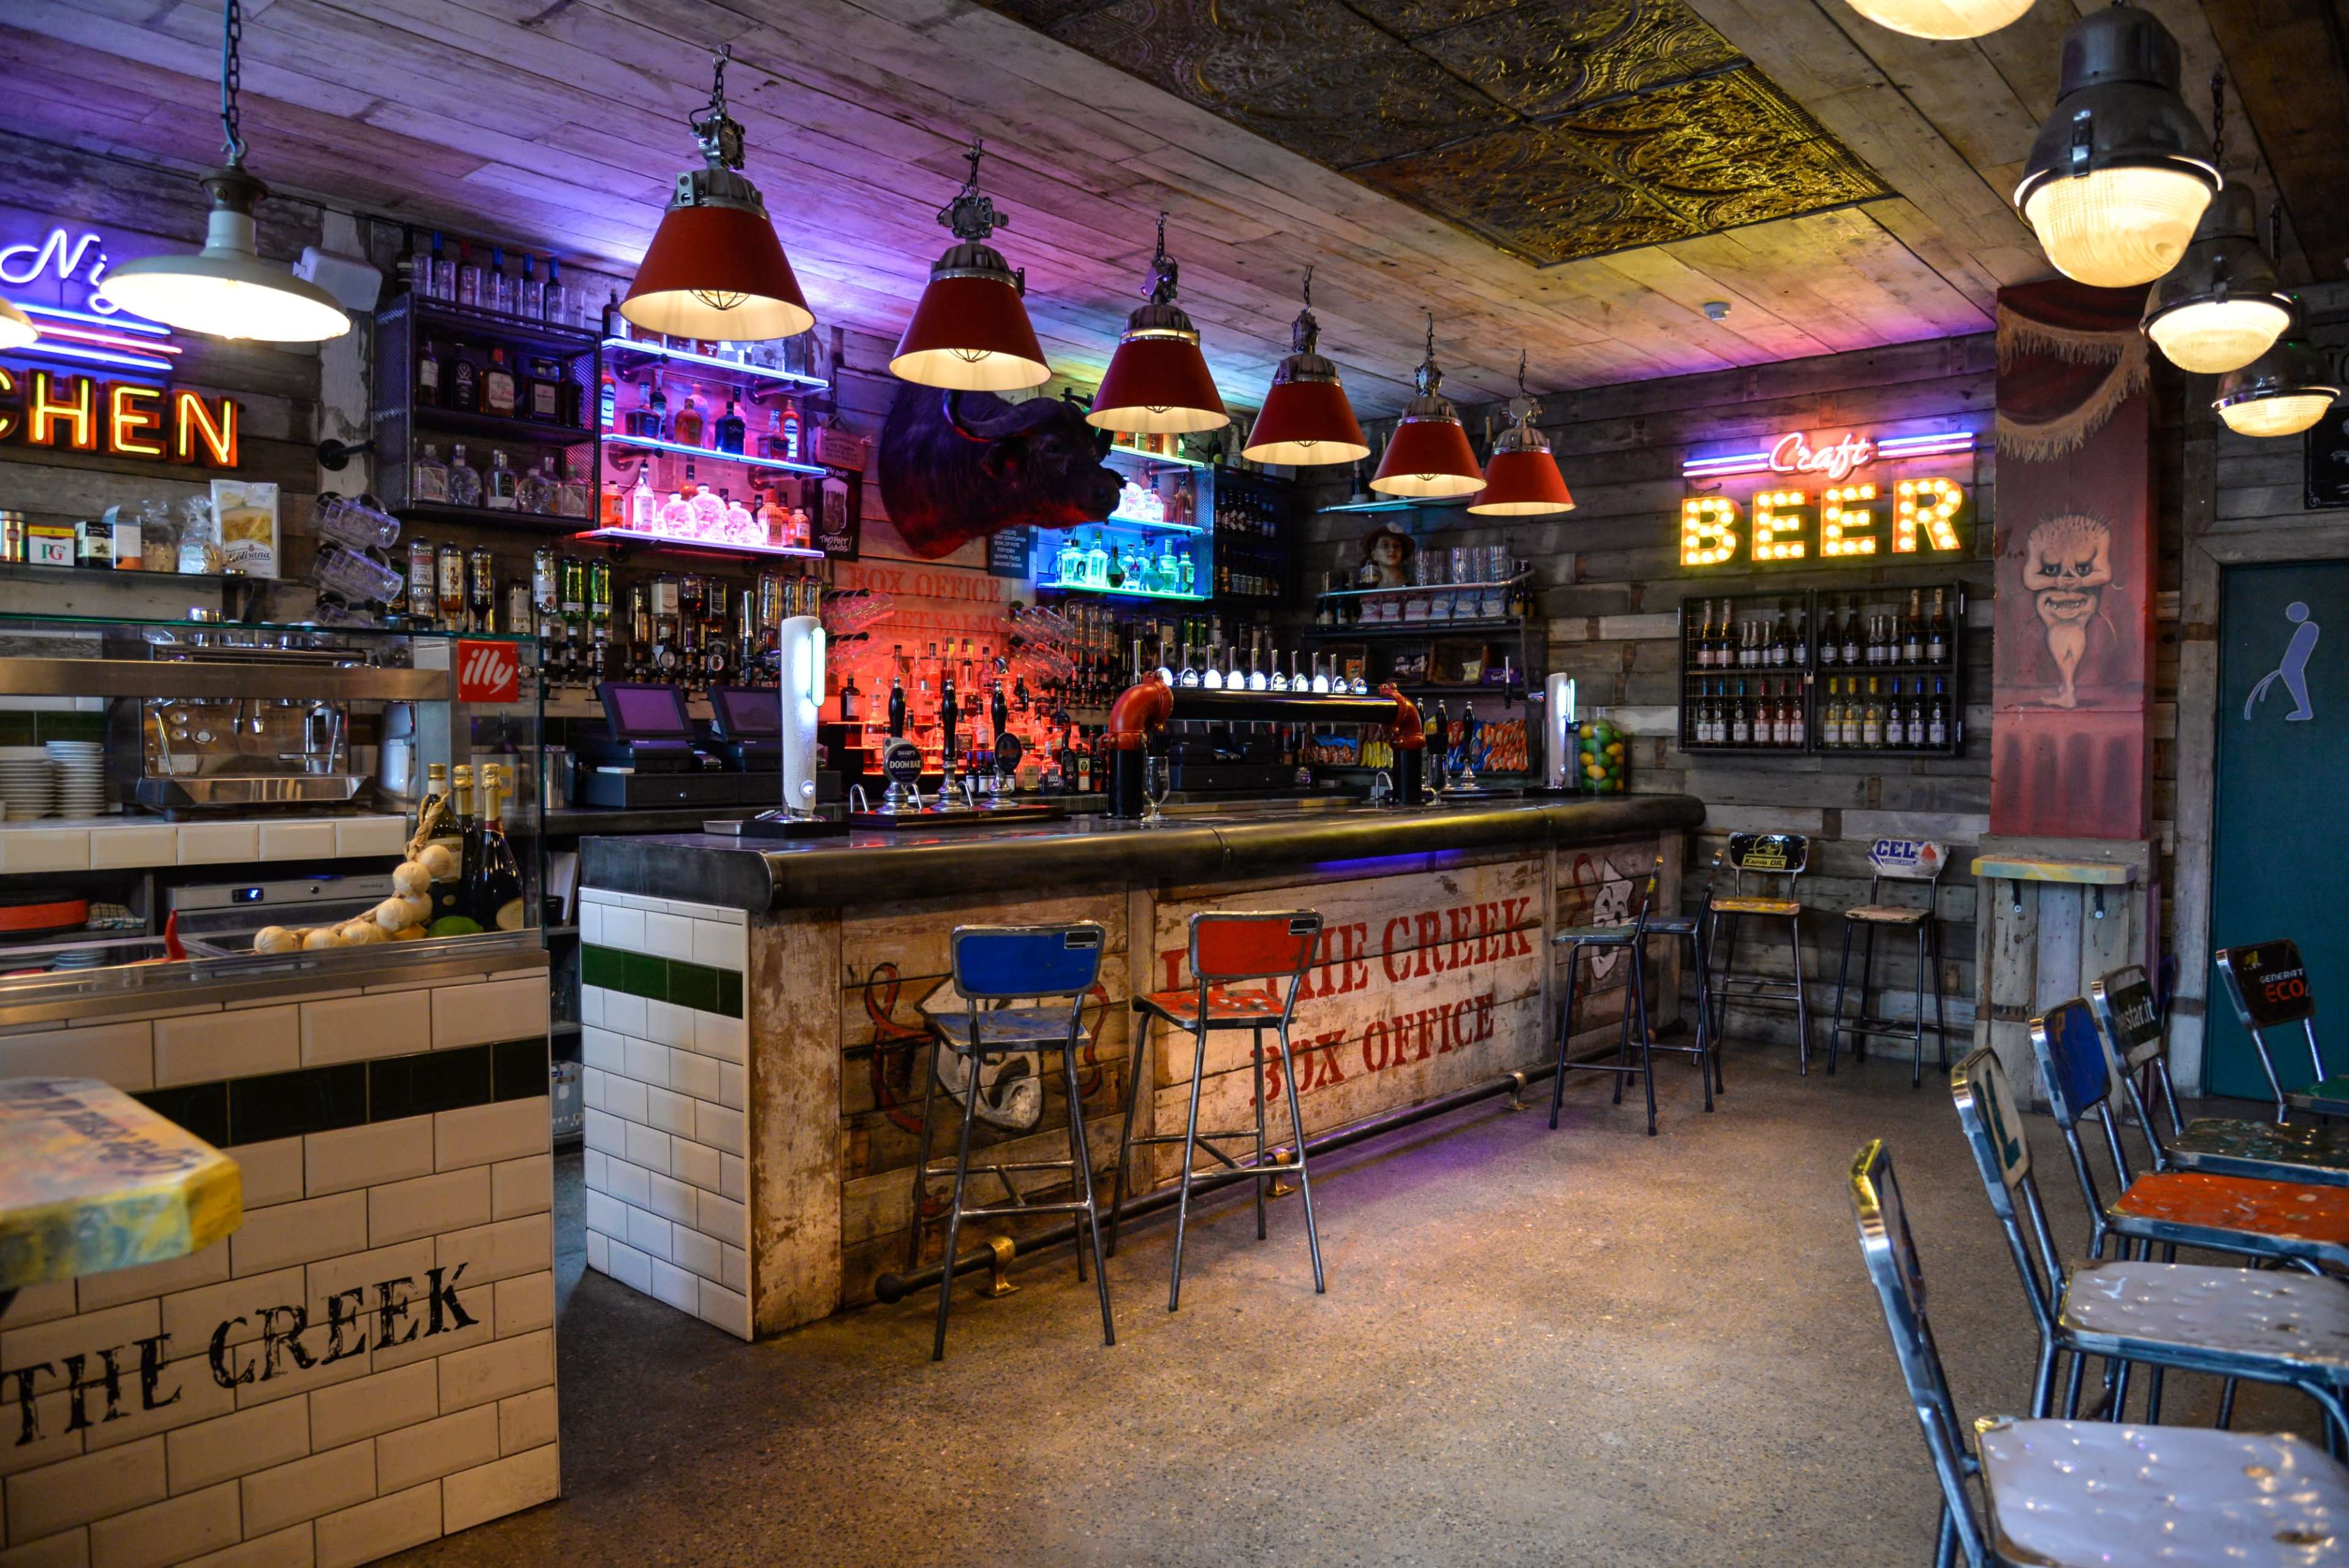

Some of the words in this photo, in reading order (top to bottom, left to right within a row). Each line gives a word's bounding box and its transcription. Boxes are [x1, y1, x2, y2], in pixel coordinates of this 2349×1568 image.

[0, 228, 121, 314] Ni
[1769, 432, 1871, 480] Craft
[1680, 477, 1963, 566] BEER
[41, 543, 63, 560] PG
[849, 565, 907, 593] BOX
[916, 573, 1001, 602] OFFICE
[462, 648, 514, 694] illy
[889, 760, 910, 769] DOOM
[1876, 839, 1924, 859] CEL
[1265, 921, 1369, 1002] HE
[1382, 896, 1532, 984] CREEK
[1249, 1029, 1346, 1106] BOX
[1362, 992, 1494, 1072] OFFICE
[0, 1333, 182, 1447] THE
[209, 1262, 480, 1389] CREEK
